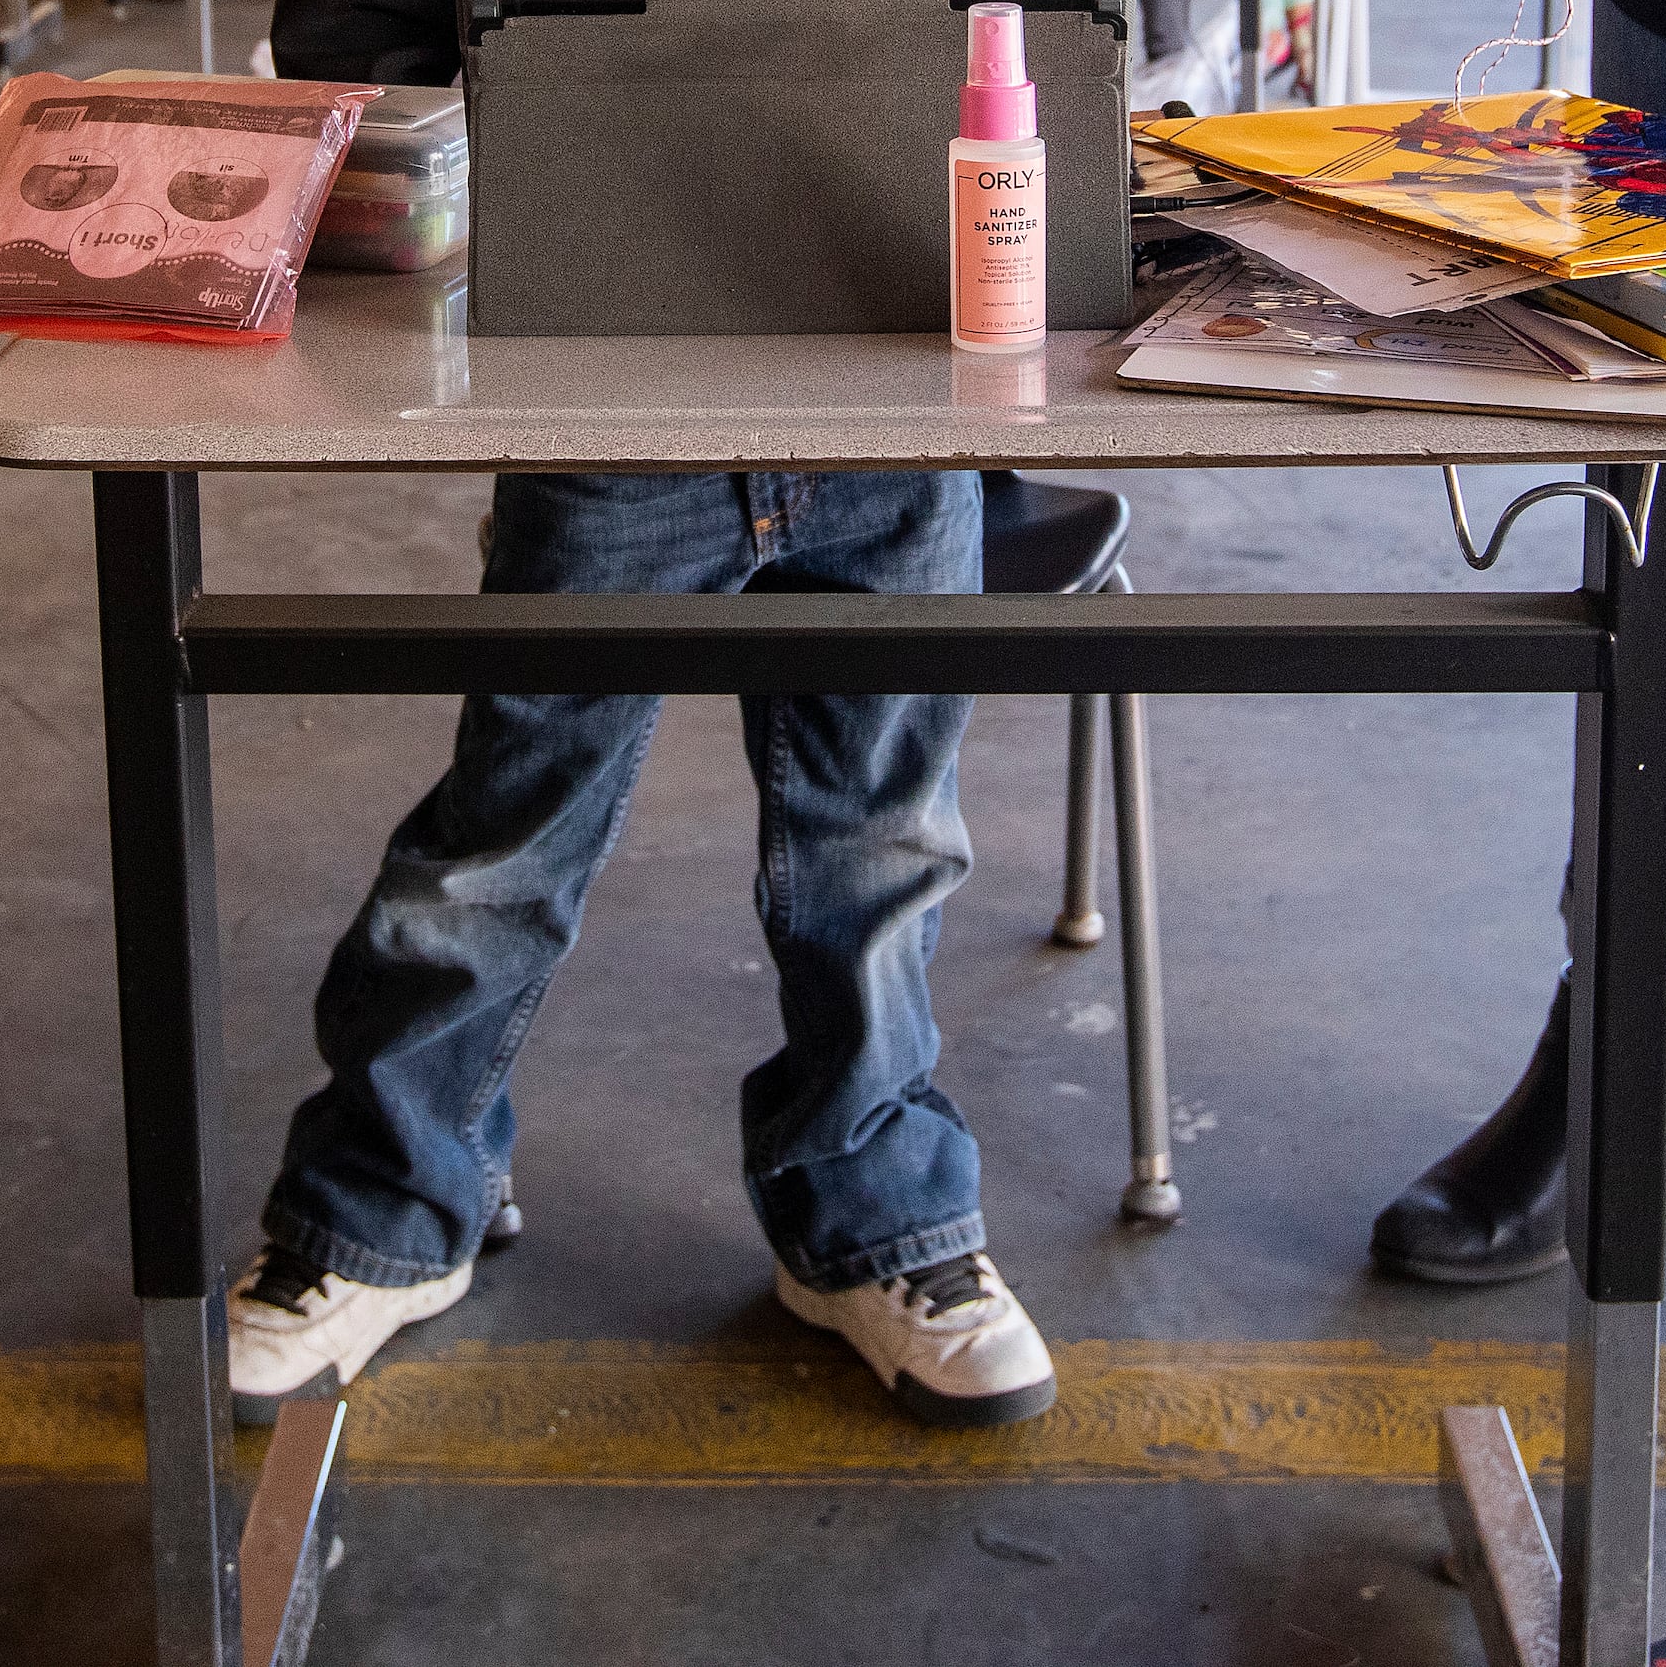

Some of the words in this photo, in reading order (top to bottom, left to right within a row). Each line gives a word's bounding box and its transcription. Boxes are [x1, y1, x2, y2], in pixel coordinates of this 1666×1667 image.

[67, 154, 91, 165] Tim
[219, 162, 236, 173] sit
[977, 168, 1034, 190] ORLY
[989, 207, 1026, 218] HAND
[974, 219, 1038, 232] SANITIZER
[79, 229, 90, 247] i
[92, 230, 159, 252] Short
[987, 234, 1028, 246] SPRAY
[985, 264, 1018, 272] Antiseptic
[198, 287, 246, 312] StartUp
